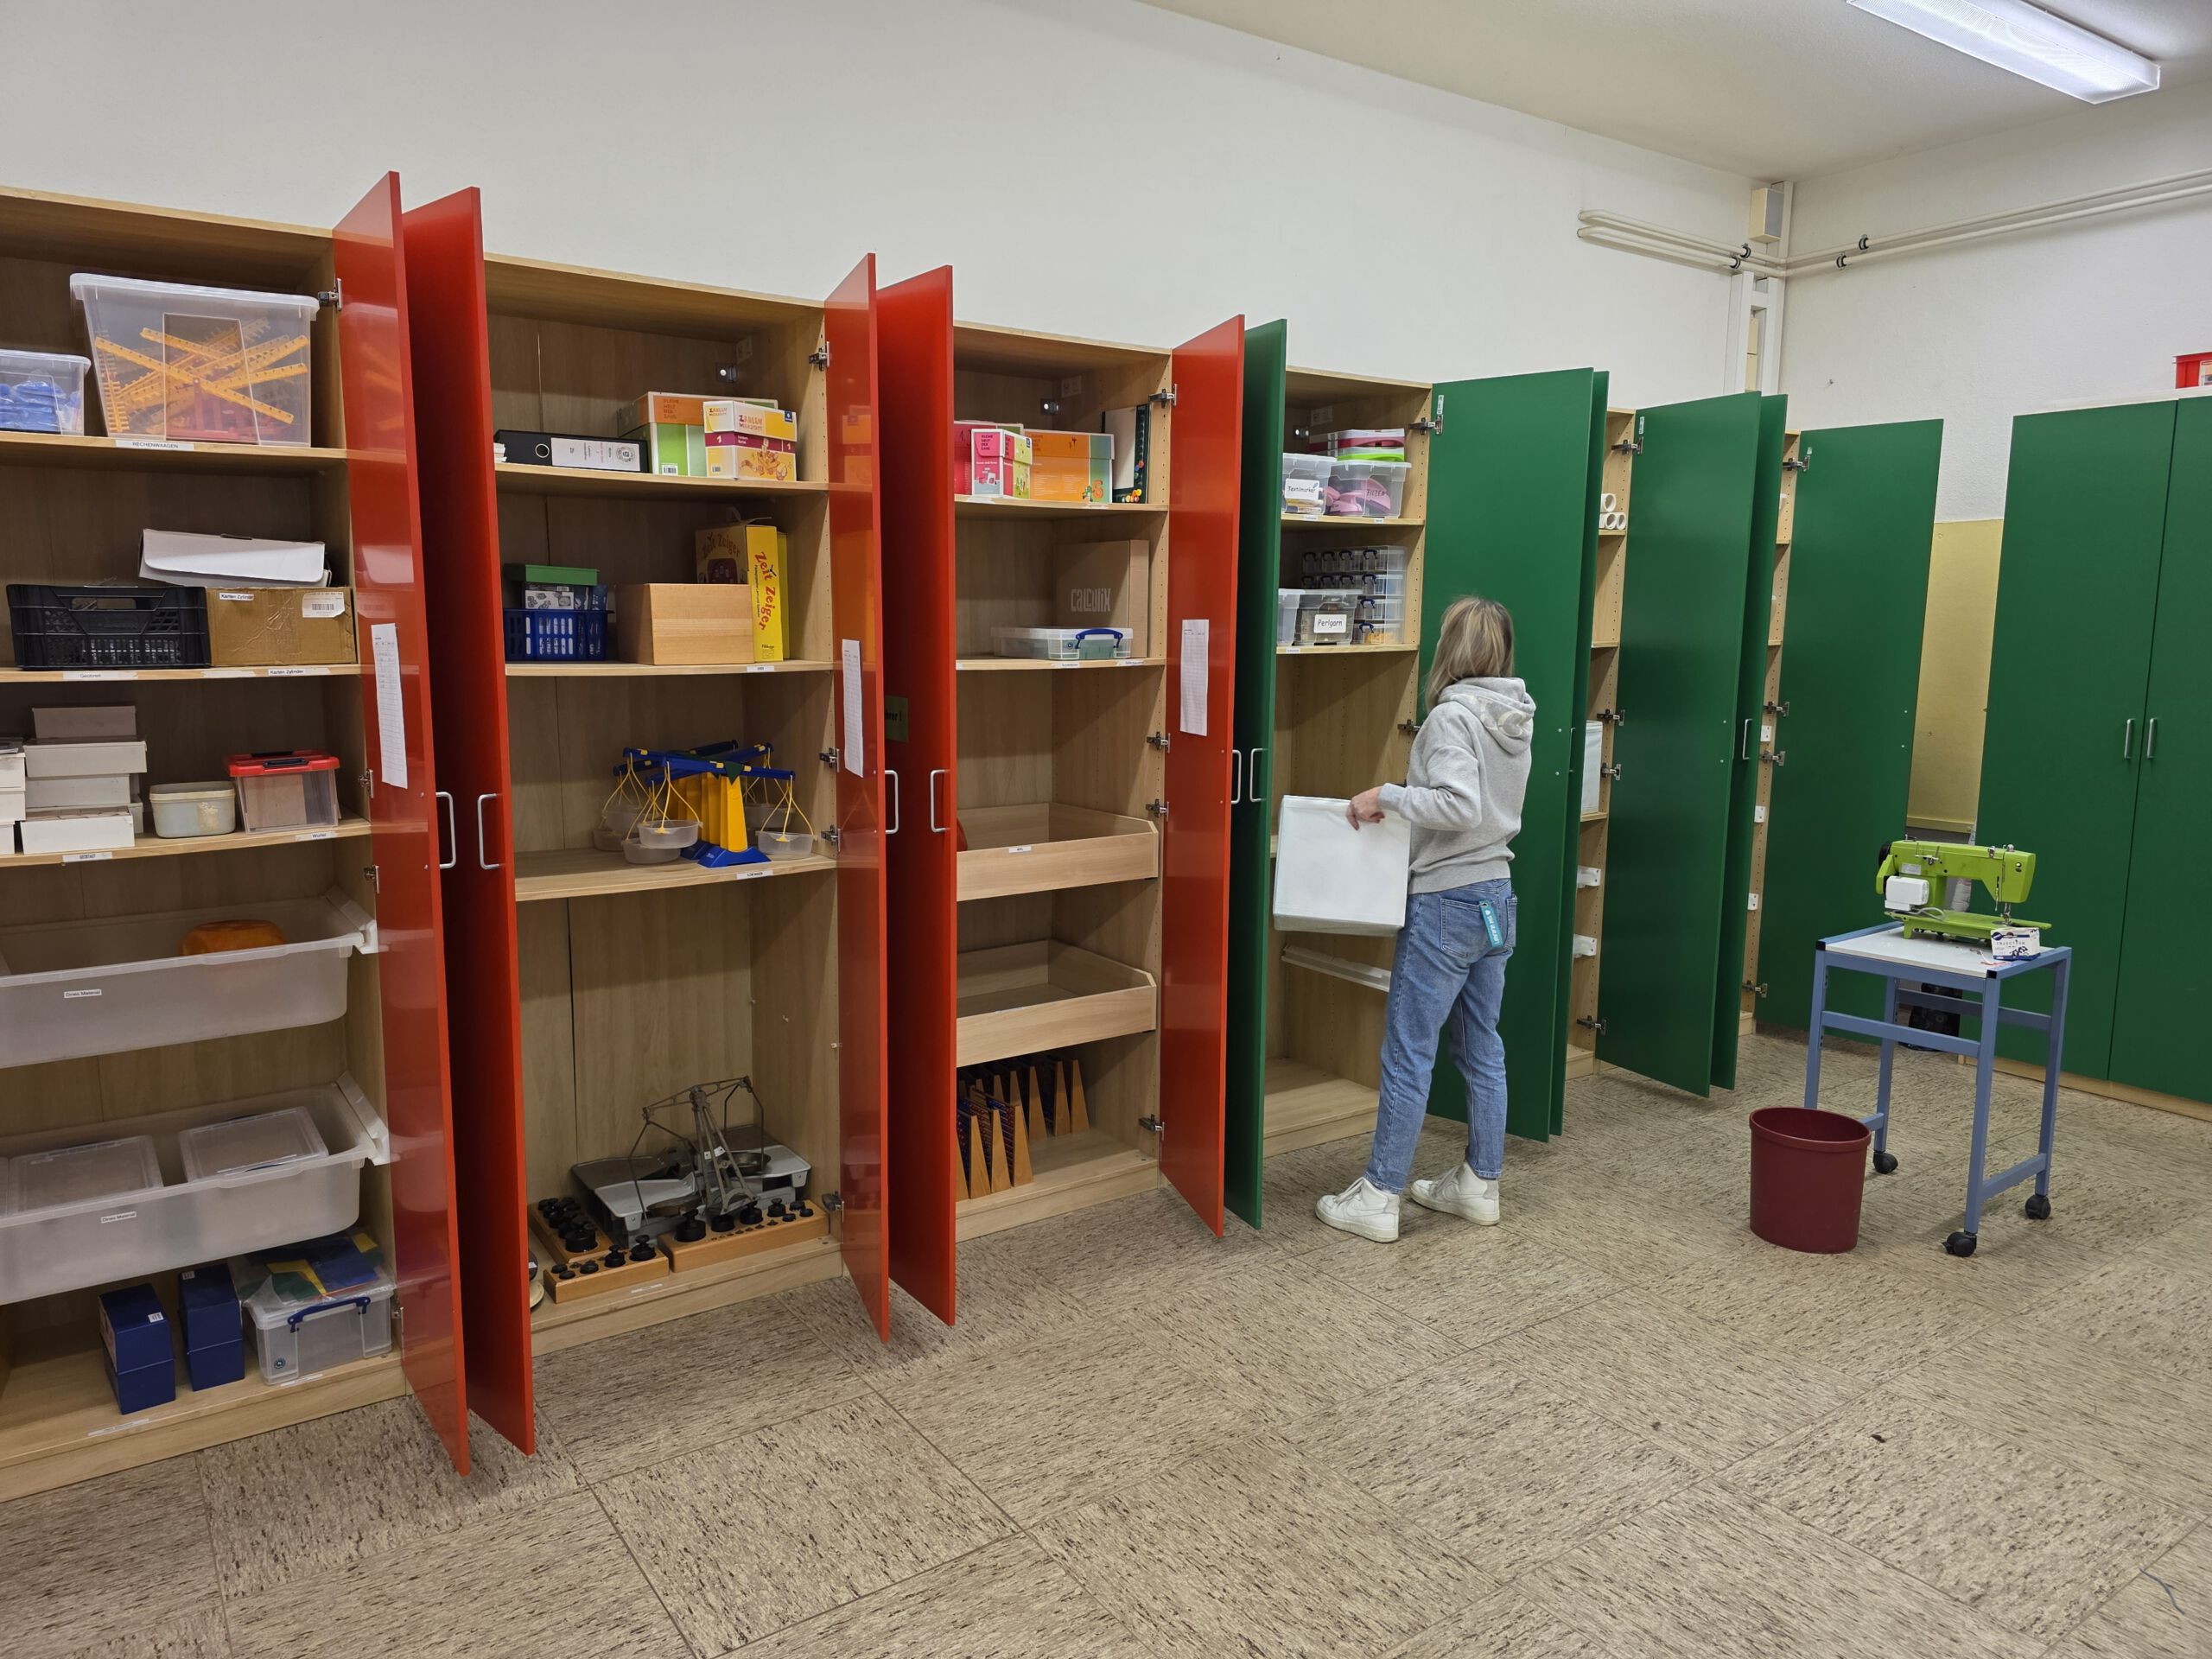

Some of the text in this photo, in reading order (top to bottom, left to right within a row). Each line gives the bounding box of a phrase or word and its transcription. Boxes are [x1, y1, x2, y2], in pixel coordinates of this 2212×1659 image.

[716, 435, 722, 443] 1
[754, 551, 772, 581] Zeit
[758, 587, 776, 631] Zeiger
[1318, 619, 1343, 629] Perlgarn
